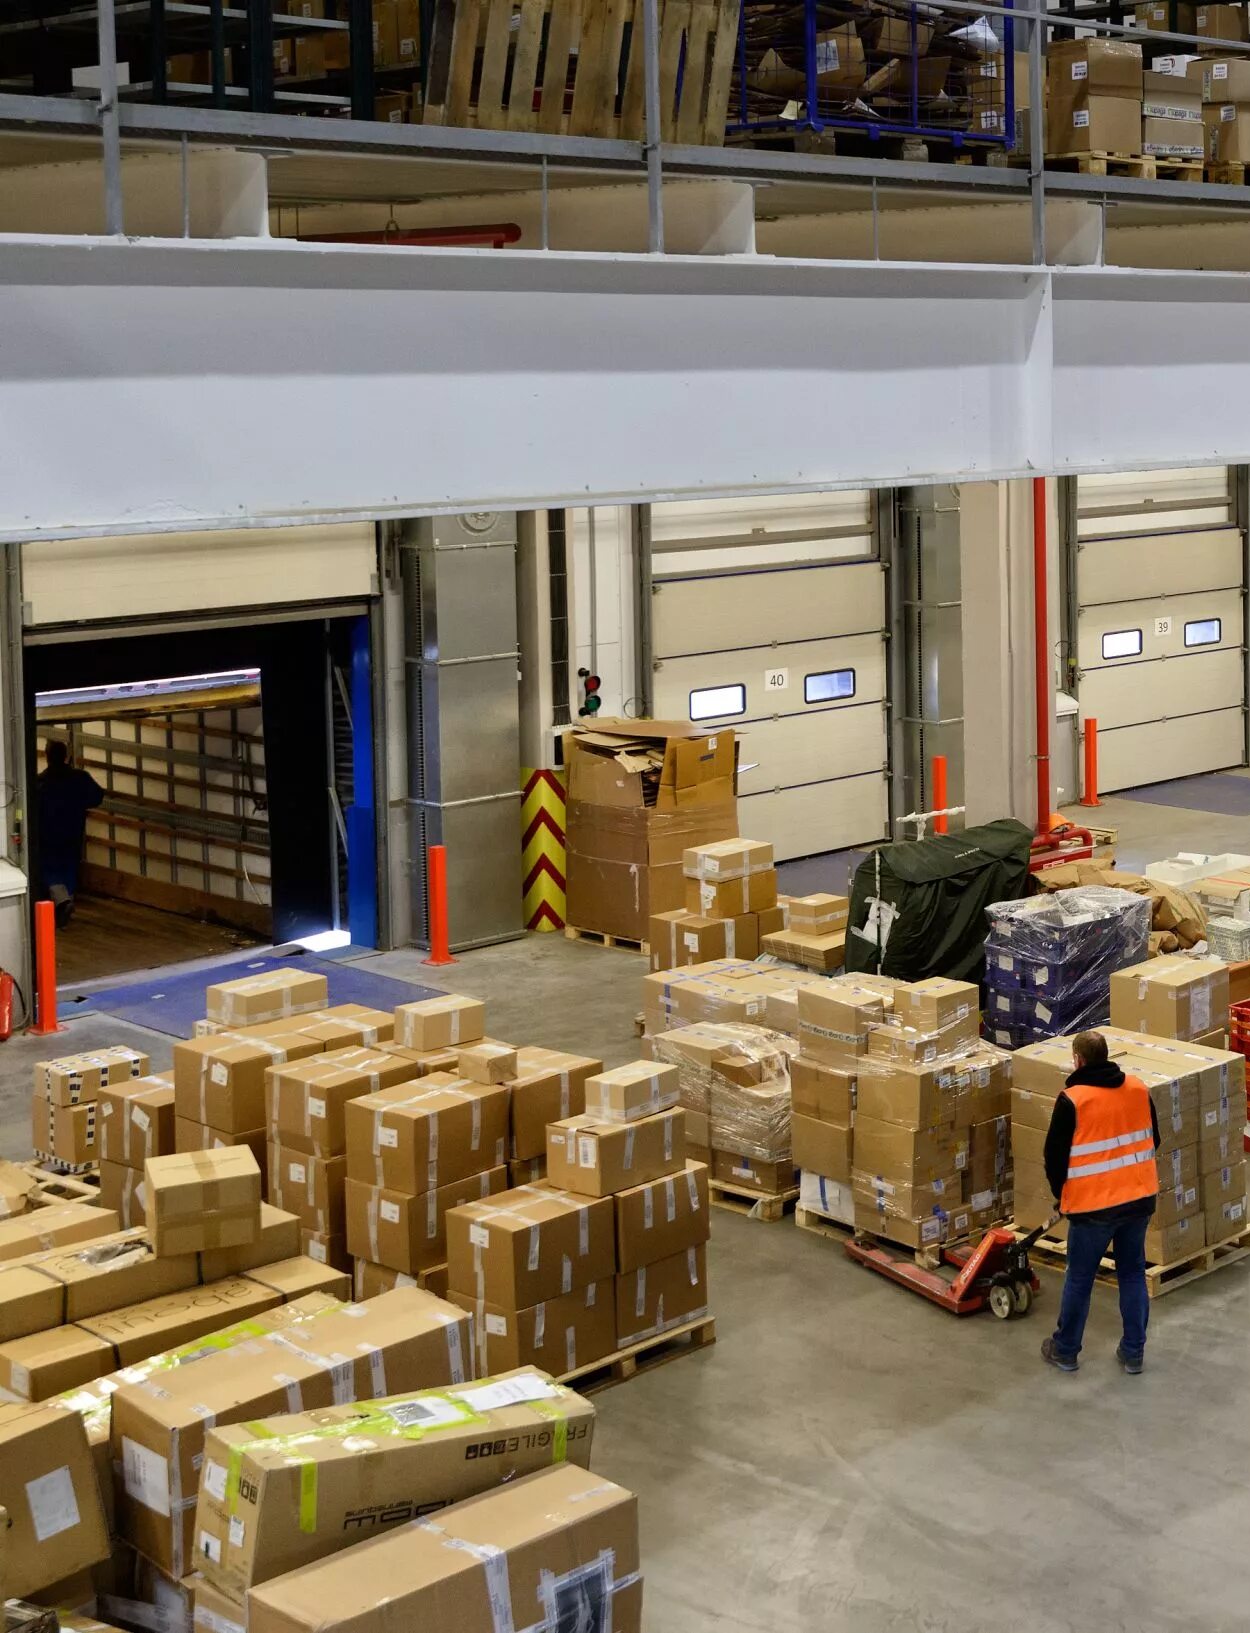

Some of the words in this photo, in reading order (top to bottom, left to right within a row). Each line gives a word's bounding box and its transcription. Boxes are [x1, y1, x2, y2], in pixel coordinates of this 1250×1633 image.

[1158, 621, 1168, 633] 39
[770, 674, 784, 687] 40
[508, 1424, 588, 1452] FRGILE
